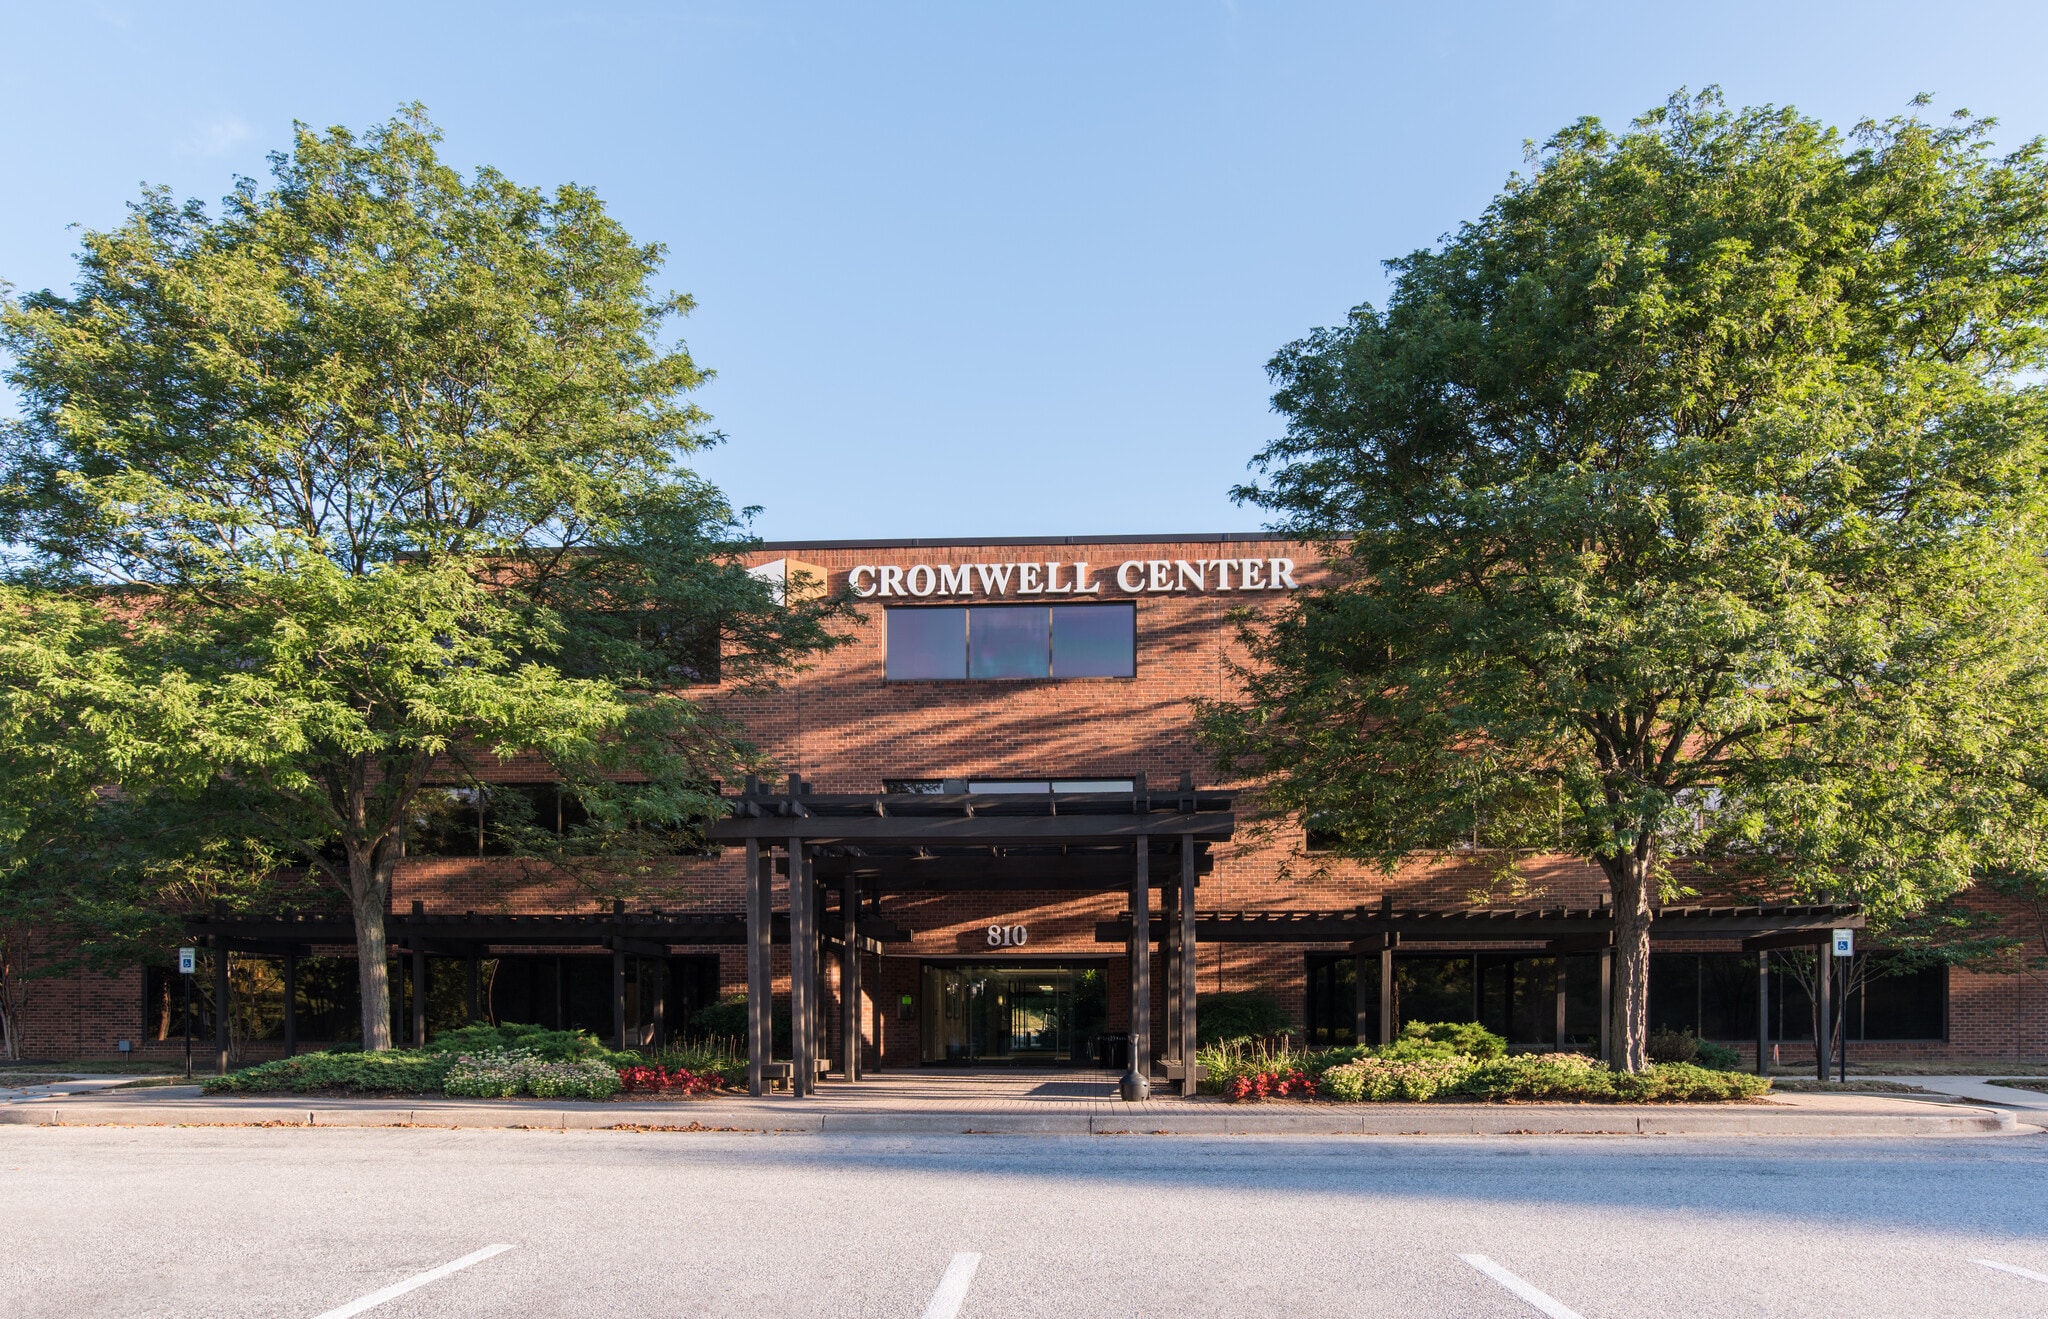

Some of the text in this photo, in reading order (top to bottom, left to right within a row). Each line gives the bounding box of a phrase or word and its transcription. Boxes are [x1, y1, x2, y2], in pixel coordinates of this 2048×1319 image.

[848, 558, 1298, 597] CROMWELL CENTER
[987, 925, 1028, 946] 810
